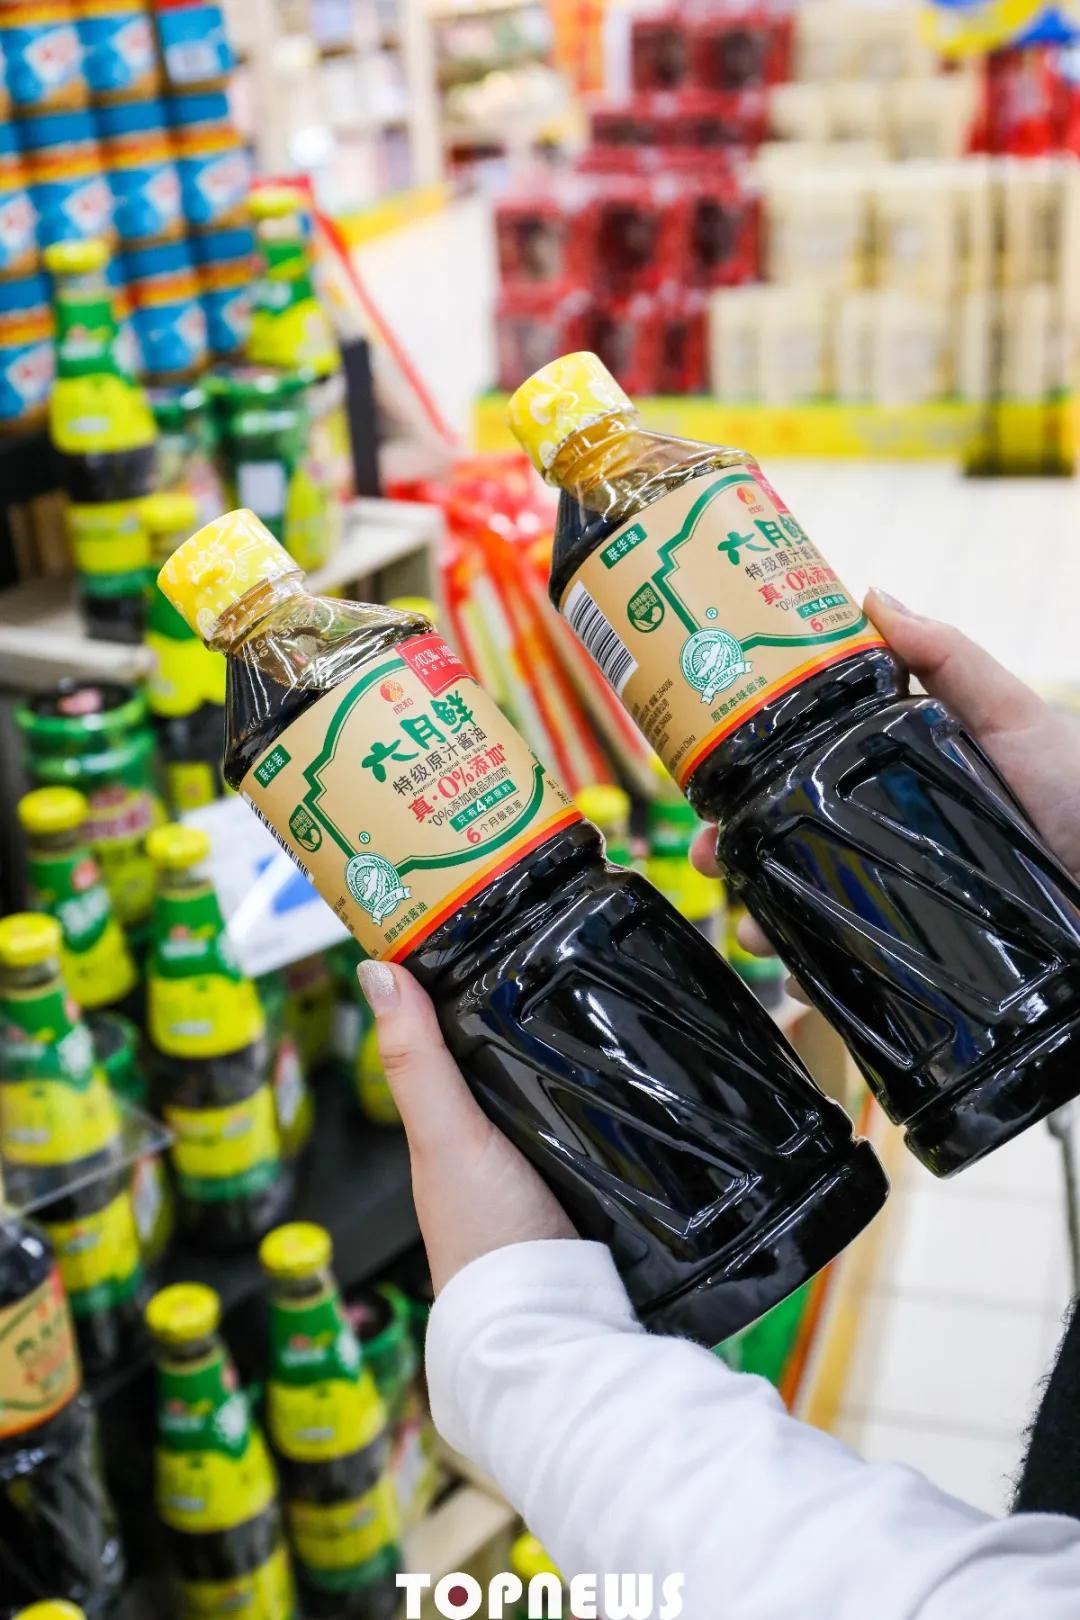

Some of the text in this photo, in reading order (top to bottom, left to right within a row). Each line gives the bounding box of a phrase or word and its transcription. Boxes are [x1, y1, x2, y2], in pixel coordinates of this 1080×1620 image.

[361, 689, 477, 783] 六月鲜
[392, 726, 488, 797] 特级原汁酱油
